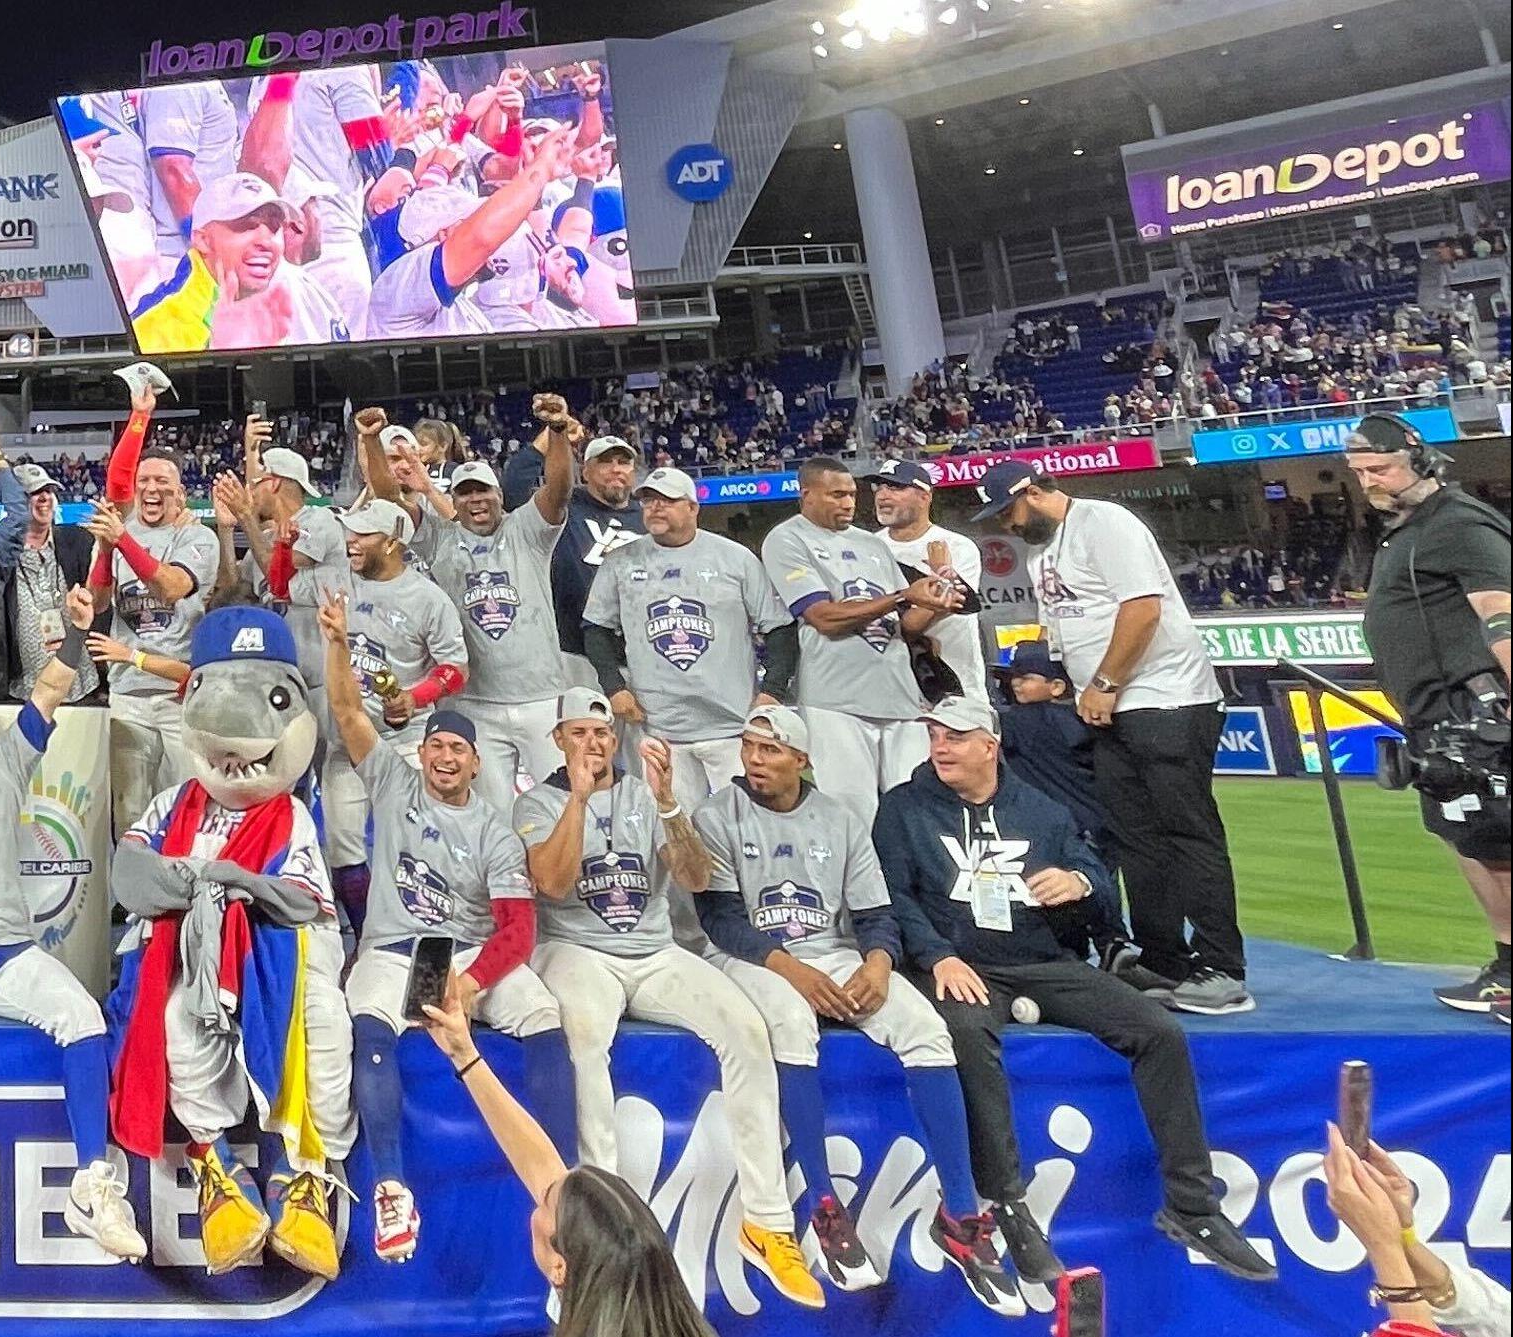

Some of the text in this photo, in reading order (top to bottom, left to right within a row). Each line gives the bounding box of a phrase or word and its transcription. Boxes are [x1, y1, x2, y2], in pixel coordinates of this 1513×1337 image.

[147, 1, 529, 77] loanDepot park
[677, 160, 724, 184] ADT
[1166, 120, 1465, 214] loanDepot
[1171, 220, 1206, 235] Home
[1207, 210, 1264, 230] Purchase
[1270, 202, 1310, 217] Home
[1310, 190, 1376, 210] Refinance
[16, 266, 38, 281] OF
[38, 263, 90, 280] MIAMI
[9, 337, 29, 356] 42
[944, 445, 1121, 482] Muational
[720, 482, 756, 497] ARCO
[648, 616, 712, 637] CAMPEONES
[1226, 627, 1257, 657] DE
[1259, 627, 1292, 657] LA
[1294, 625, 1365, 656] SERIE
[579, 873, 649, 892] CAMPEONES
[755, 907, 829, 928] CAMPEONES
